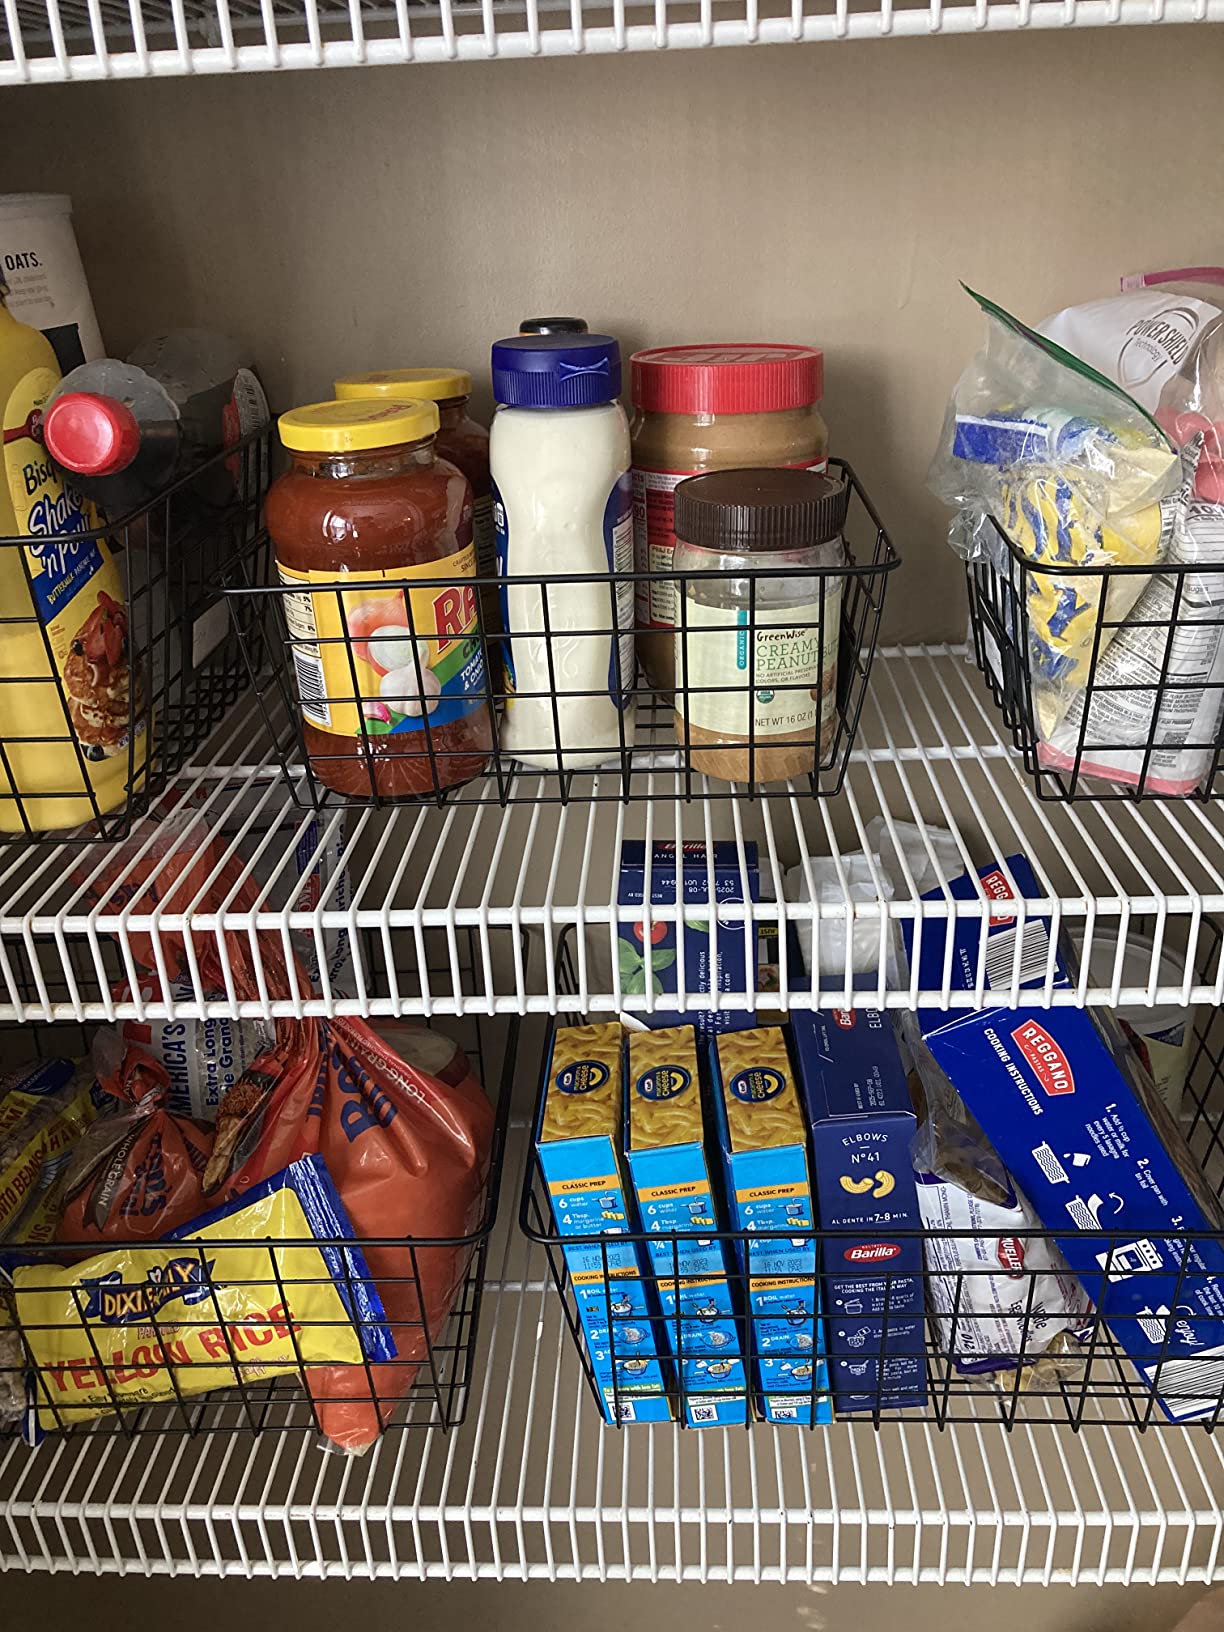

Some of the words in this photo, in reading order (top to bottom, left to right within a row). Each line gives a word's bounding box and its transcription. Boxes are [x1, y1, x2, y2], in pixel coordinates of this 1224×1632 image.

[5, 252, 43, 270] OATS.
[1127, 319, 1188, 365] POWERSHIELD
[23, 460, 57, 495] Bisq
[432, 587, 478, 655] RA
[756, 630, 807, 642] GreenWise
[460, 648, 483, 681] TOMAT
[756, 650, 818, 671] PEANUT
[766, 670, 793, 678] ARTIFICIAL
[755, 717, 770, 727] NET
[771, 716, 784, 726] WT
[786, 715, 796, 724] 16
[697, 951, 706, 979] delicious
[1022, 1026, 1069, 1091] REGGANO
[1029, 1052, 1045, 1074] PASTAS
[162, 1023, 193, 1117] MERICA'S
[984, 1027, 1011, 1063] COOKING
[1005, 1062, 1044, 1116] INSTRUCTIONS
[206, 1063, 219, 1105] Extra
[1105, 1103, 1117, 1113] 1.
[1110, 1113, 1122, 1127] Add
[841, 1132, 889, 1147] ELBOWS
[1120, 1131, 1130, 1143] cup
[1137, 1158, 1149, 1170] 2.
[1142, 1168, 1157, 1185] Cover
[98, 1173, 121, 1207] GRAIN
[651, 1188, 677, 1197] CLASSIC
[679, 1186, 696, 1194] PREP
[559, 1198, 568, 1208] 6
[648, 1205, 656, 1214] 6
[745, 1205, 753, 1215] 6
[562, 1214, 572, 1225] 4
[842, 1216, 864, 1224] DENTE
[874, 1212, 891, 1223] 7-8
[1171, 1215, 1183, 1227] 3.
[651, 1220, 660, 1231] 4
[747, 1220, 756, 1230] 4
[850, 1246, 897, 1260] Barilla
[574, 1274, 599, 1282] COOKING
[580, 1289, 588, 1299] 1
[756, 1296, 764, 1306] 1
[590, 1330, 599, 1340] 2
[43, 1339, 192, 1392] YELLOW
[198, 1299, 302, 1360] RICE
[762, 1337, 771, 1347] 2
[595, 1351, 605, 1361] 3
